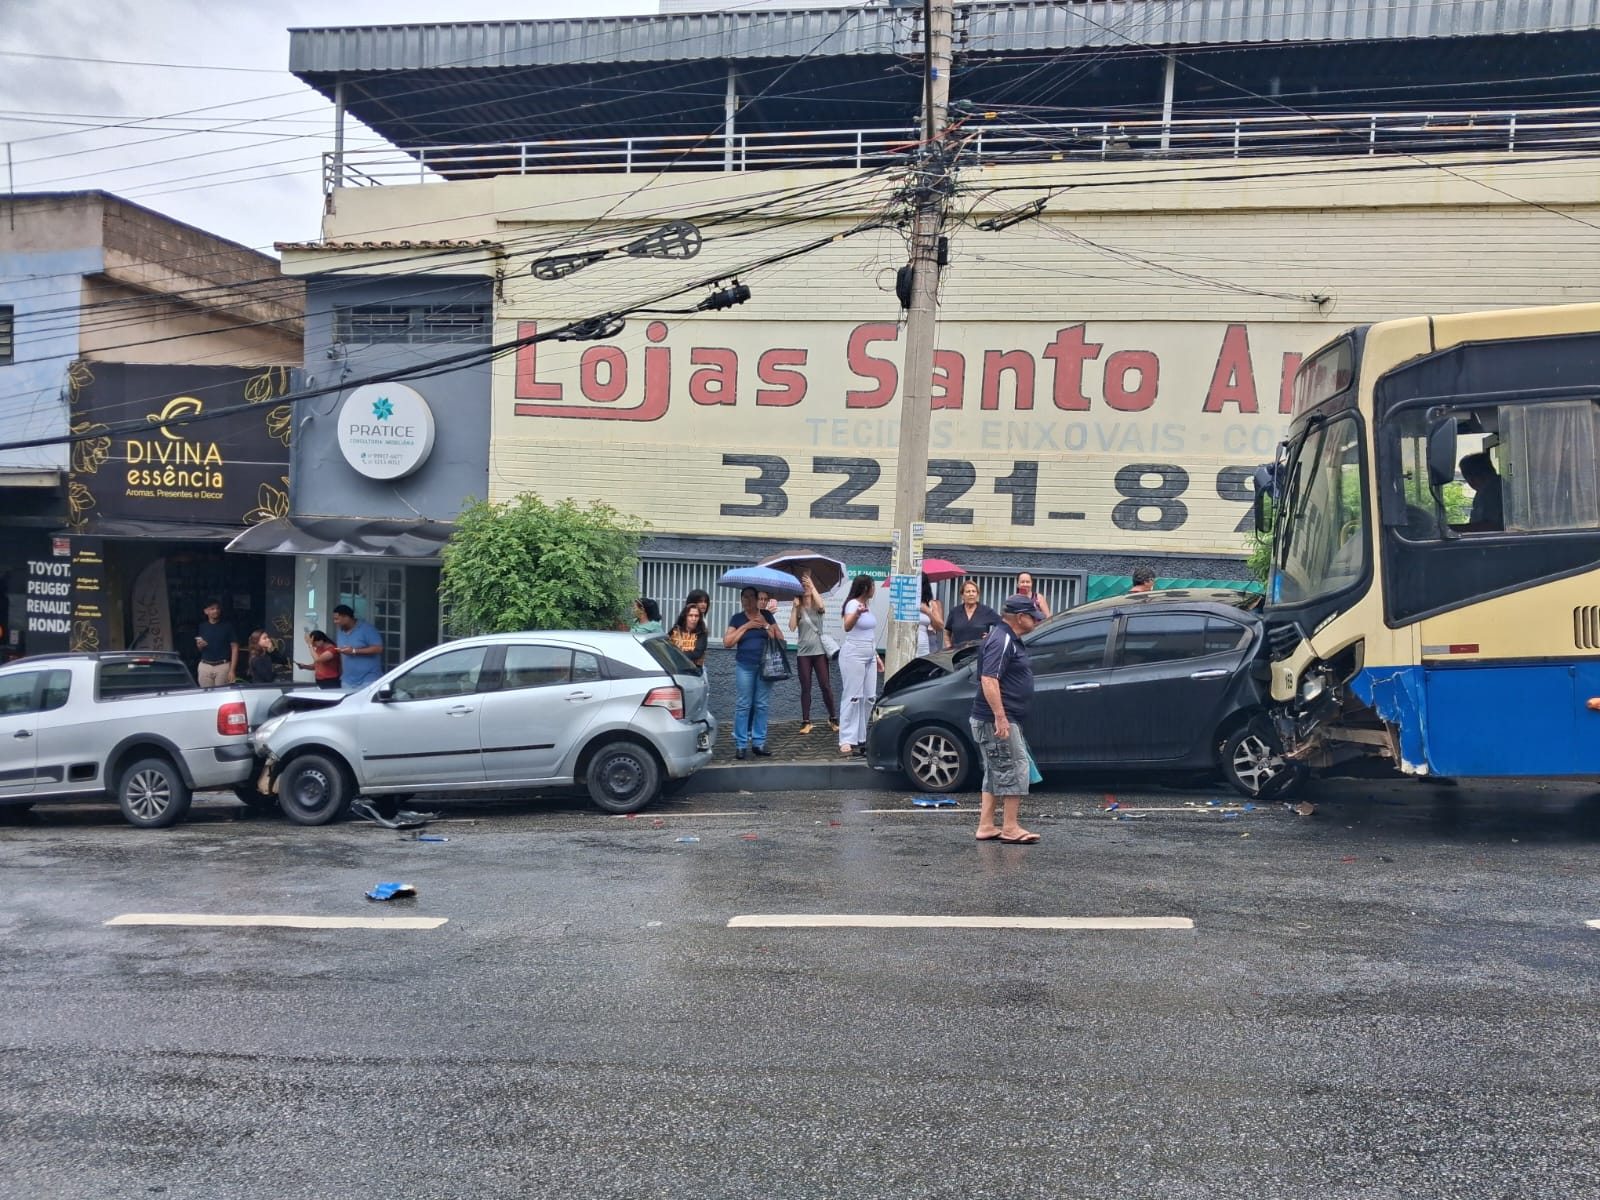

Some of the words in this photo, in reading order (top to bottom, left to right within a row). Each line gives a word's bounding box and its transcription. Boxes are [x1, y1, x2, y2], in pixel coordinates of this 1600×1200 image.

[514, 320, 808, 422] Lojas
[846, 322, 1160, 412] Santo
[1202, 324, 1303, 414] A
[350, 424, 416, 438] PRATICE
[805, 417, 952, 449] TECIDS
[981, 420, 1185, 453] ENXOVAIS
[1223, 423, 1288, 455] CO
[127, 440, 222, 466] DIVINA
[127, 464, 223, 488] essência
[156, 489, 193, 499] Presentes
[200, 490, 224, 499] Decor
[27, 560, 71, 577] TOYOT
